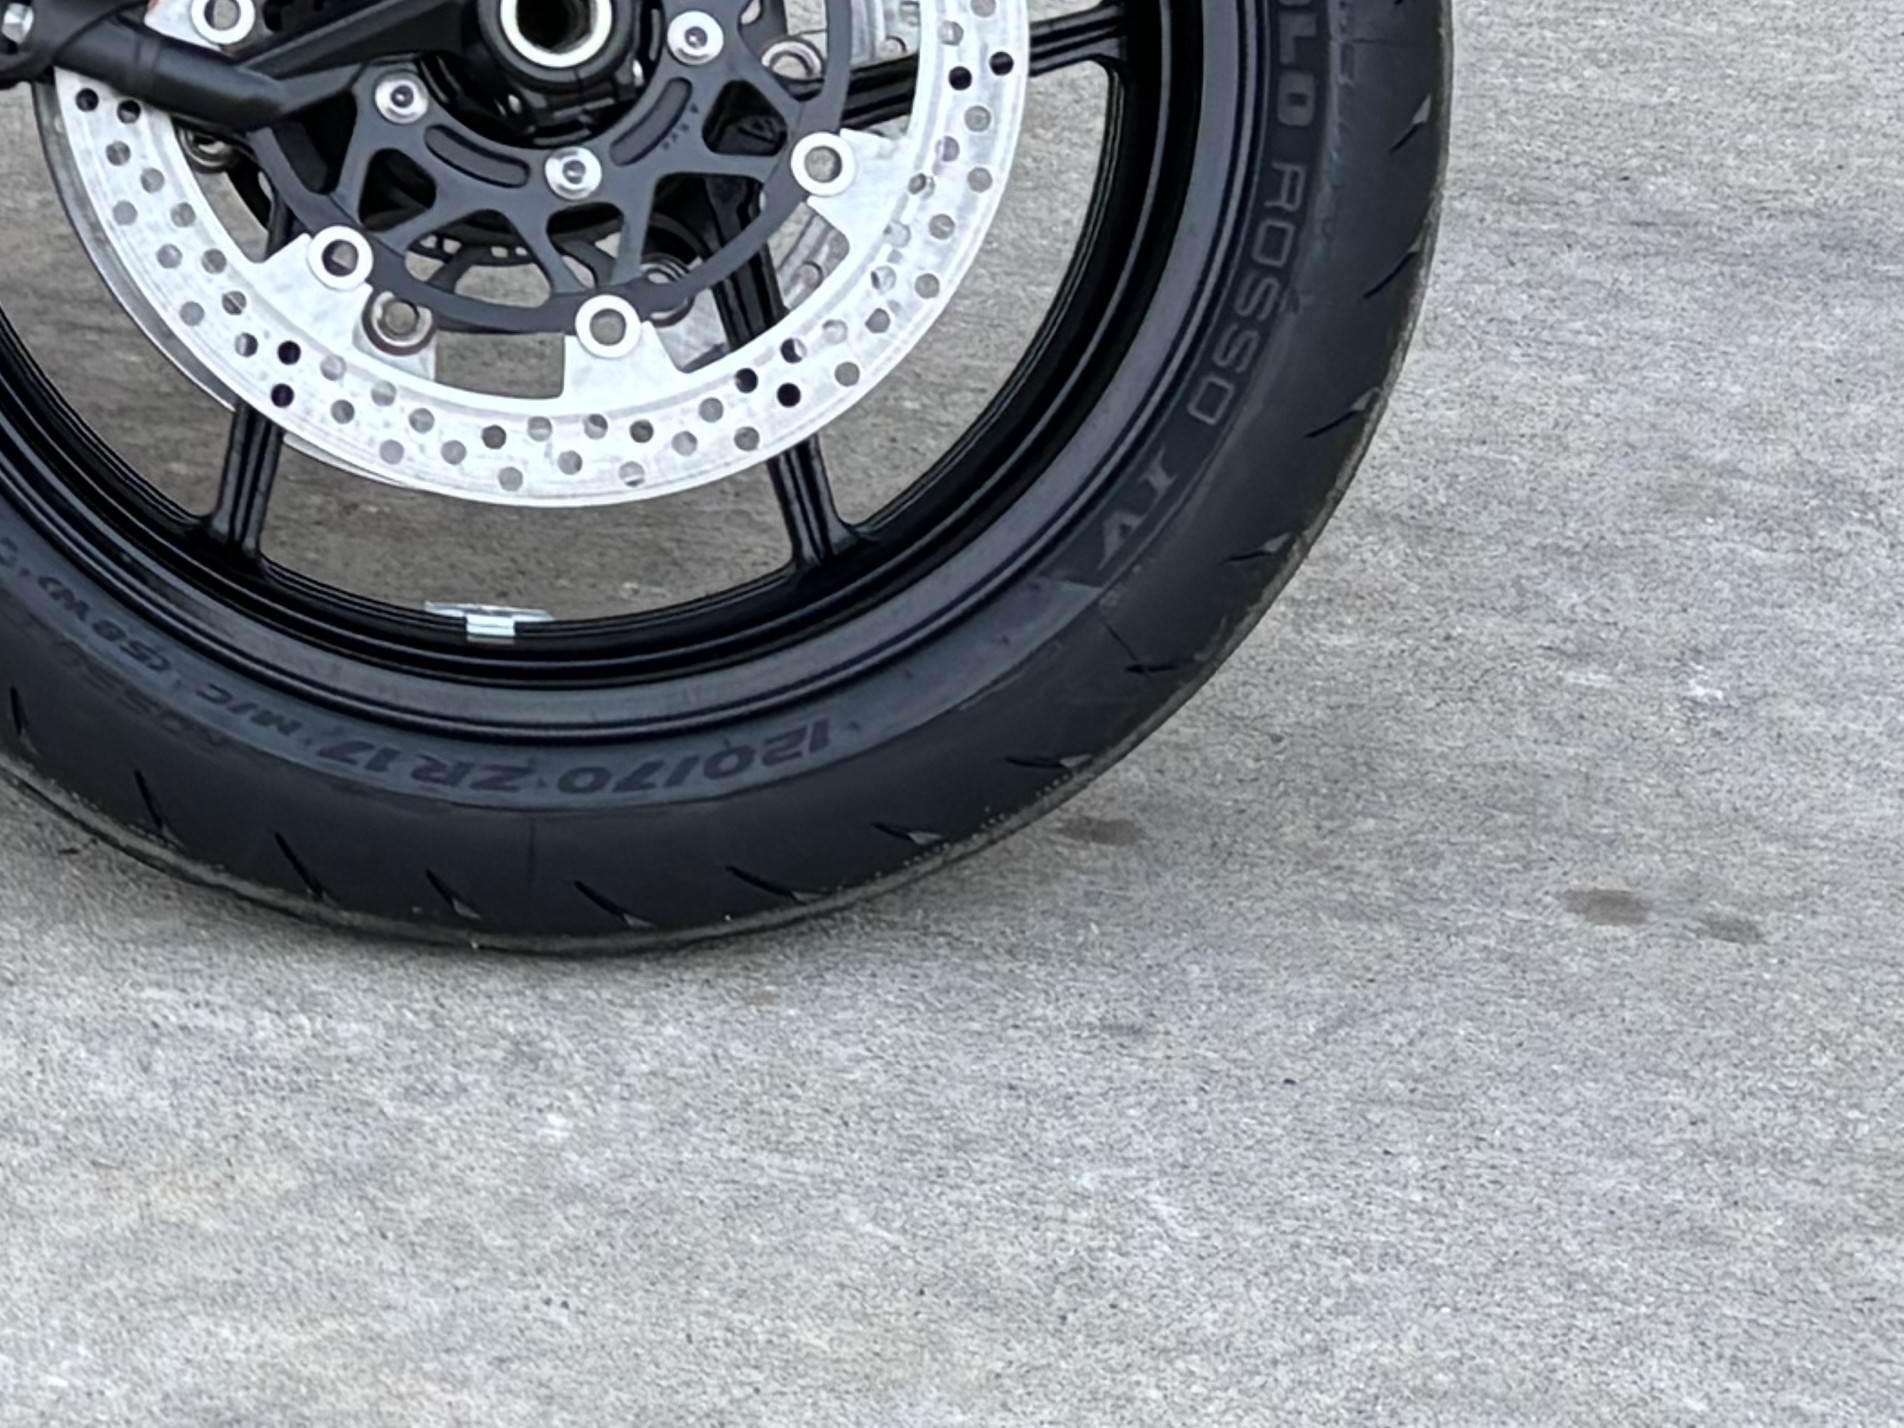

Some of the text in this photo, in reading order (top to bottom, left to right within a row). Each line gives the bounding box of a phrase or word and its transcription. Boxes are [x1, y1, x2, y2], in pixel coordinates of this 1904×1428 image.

[1185, 159, 1307, 429] ROSSO
[1096, 444, 1182, 574] IV
[557, 717, 832, 794] 120/70
